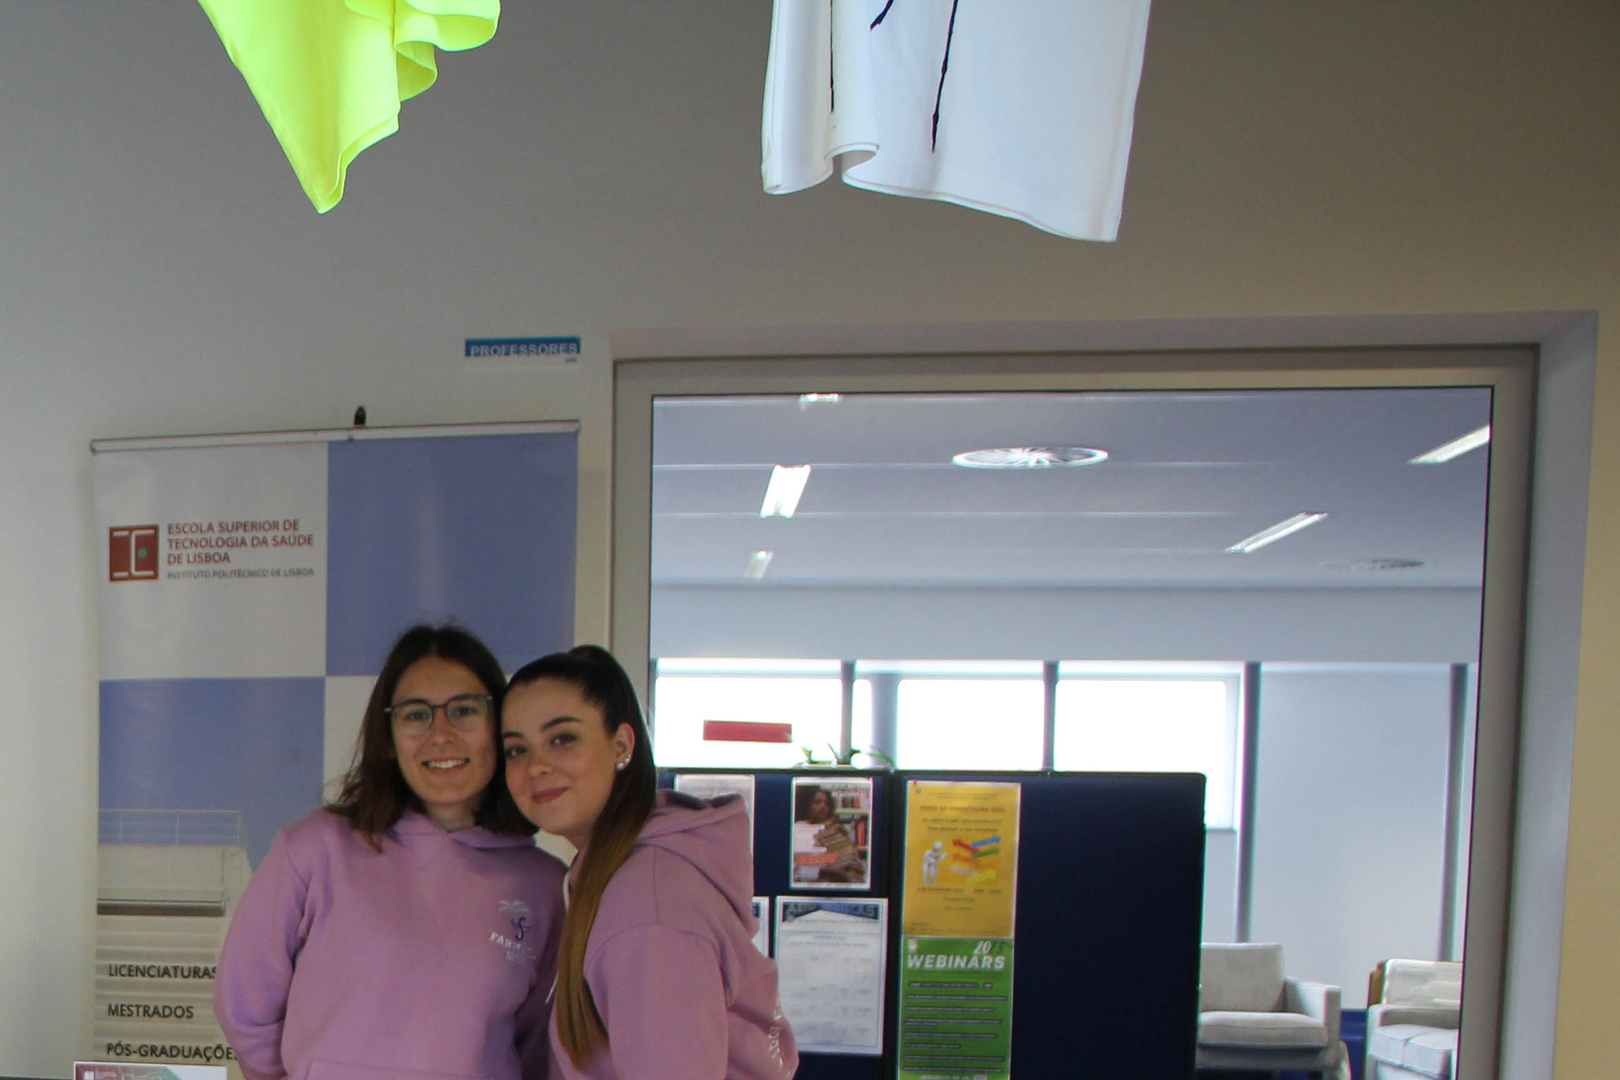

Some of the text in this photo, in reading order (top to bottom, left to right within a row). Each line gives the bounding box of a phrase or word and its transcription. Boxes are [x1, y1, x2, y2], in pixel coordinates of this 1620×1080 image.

[470, 342, 578, 357] PROFESSORES
[167, 518, 300, 534] ESCOLA SUPERIOR DE
[167, 533, 314, 549] TECNOLOGIA DA SAÚDE
[167, 551, 230, 565] DE LISBOA
[167, 567, 315, 580] INSTITUTO POLITÉCNICO DE LISBOA
[907, 954, 1006, 970] WEBINARS
[108, 1004, 194, 1019] MESTRADOS
[107, 1041, 237, 1063] PÓS-GRADUAÇÕE
